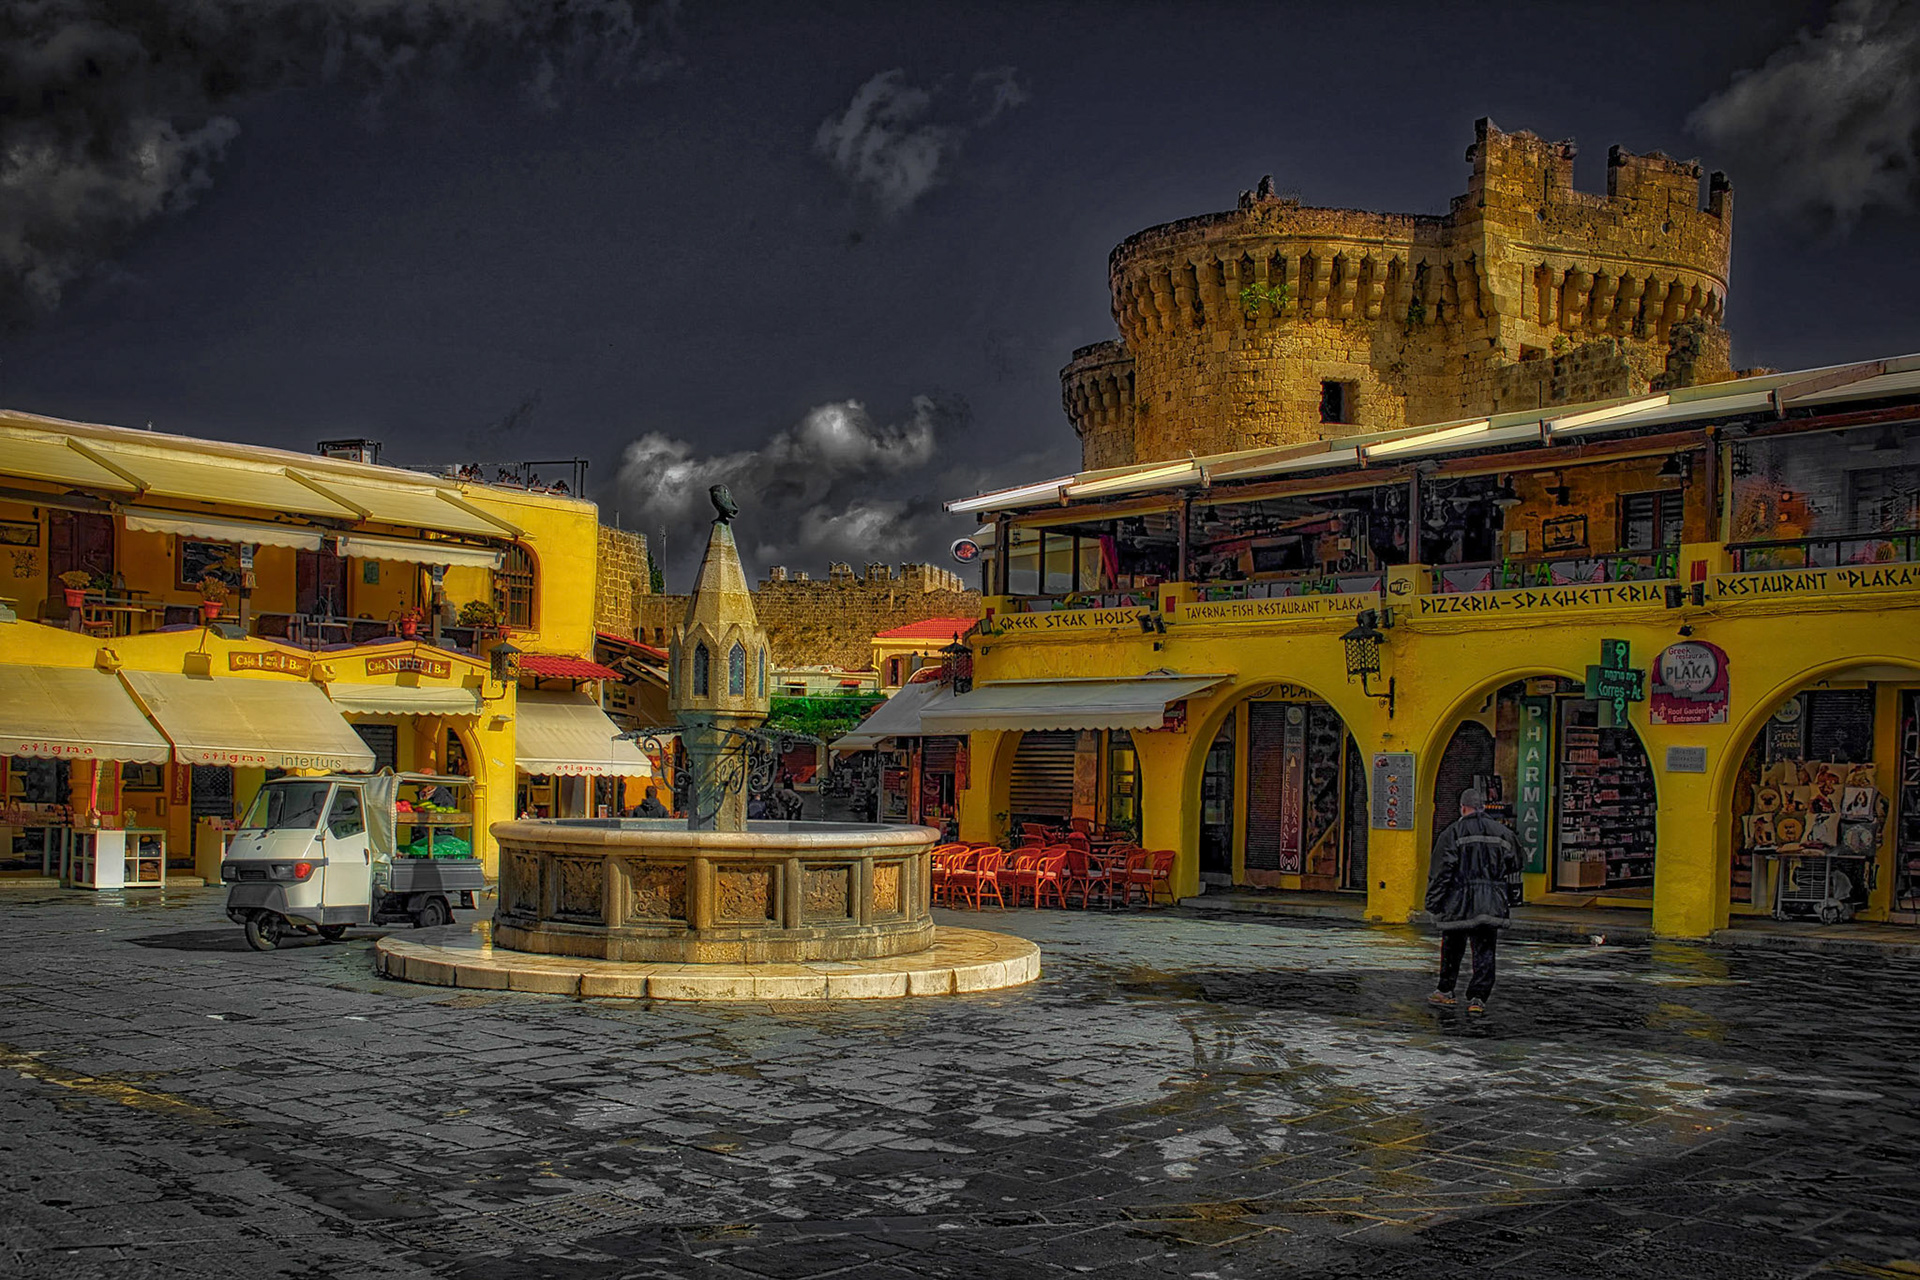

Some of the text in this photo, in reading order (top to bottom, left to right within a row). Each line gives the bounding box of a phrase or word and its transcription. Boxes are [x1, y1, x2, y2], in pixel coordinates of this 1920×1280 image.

[1716, 573, 1827, 596] RESTAURANT
[1185, 595, 1369, 619] TAVERNA-FISH RESTAURANT "PLAKA"
[1420, 585, 1662, 613] PIZZERIA-SPAGHETTERIA
[999, 616, 1038, 630] GREEK
[1045, 613, 1087, 628] STEAK
[1668, 645, 1692, 656] Greek
[1675, 652, 1709, 660] restaurant
[386, 657, 432, 673] NEFELI
[1666, 664, 1712, 680] PLAKA
[1667, 706, 1707, 715] Roof Garden
[1672, 715, 1702, 723] Entrance
[19, 742, 94, 755] stigma
[202, 751, 342, 769] stigma interfurs
[556, 764, 603, 773] stigma
[1523, 705, 1542, 863] PHARMACY
